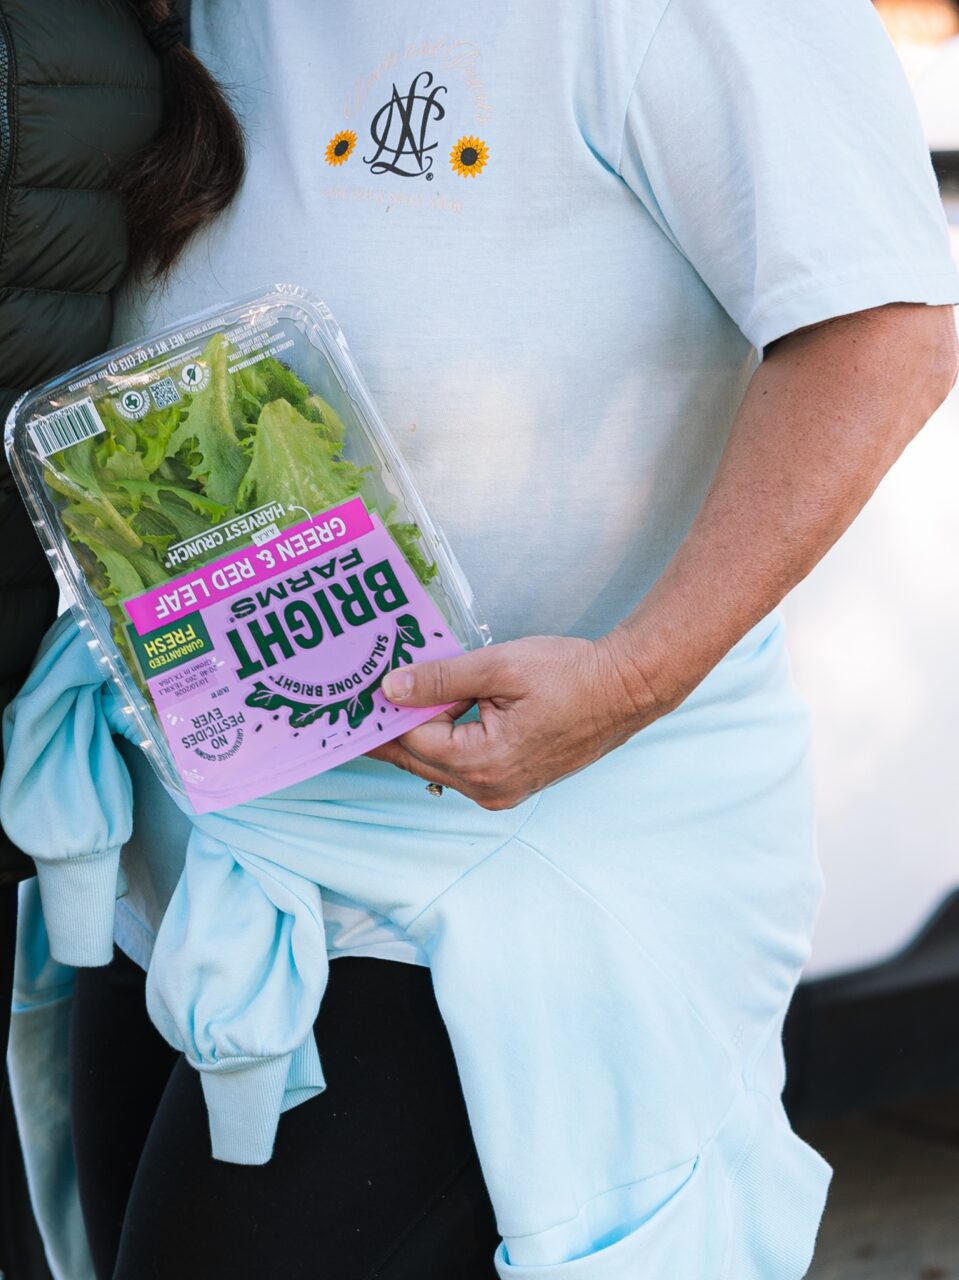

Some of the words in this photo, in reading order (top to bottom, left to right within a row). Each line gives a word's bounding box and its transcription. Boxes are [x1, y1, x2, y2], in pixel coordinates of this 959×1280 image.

[145, 346, 154, 356] 4
[154, 340, 168, 353] WT
[168, 333, 185, 348] NET
[107, 361, 117, 374] g)
[117, 353, 135, 370] (113
[134, 349, 146, 361] OZ
[223, 503, 285, 540] HARVEST
[167, 530, 224, 565] CRUNCH
[275, 514, 347, 561] GREEN
[255, 547, 276, 569] &
[209, 557, 255, 591] RED
[228, 547, 363, 619] FARMS
[151, 577, 210, 618] LEAF
[225, 560, 409, 678] BRIGHT
[144, 623, 195, 657] FRESH
[148, 638, 204, 668] GUARANTEED
[189, 658, 212, 672] Grown
[361, 633, 388, 676] SALAD
[327, 672, 360, 696] DONE
[181, 712, 244, 748] PESTICIDES
[190, 707, 222, 728] EVER
[194, 746, 216, 760] GROWN
[209, 734, 228, 750] NO
[215, 727, 244, 761] GREENHOUSE
